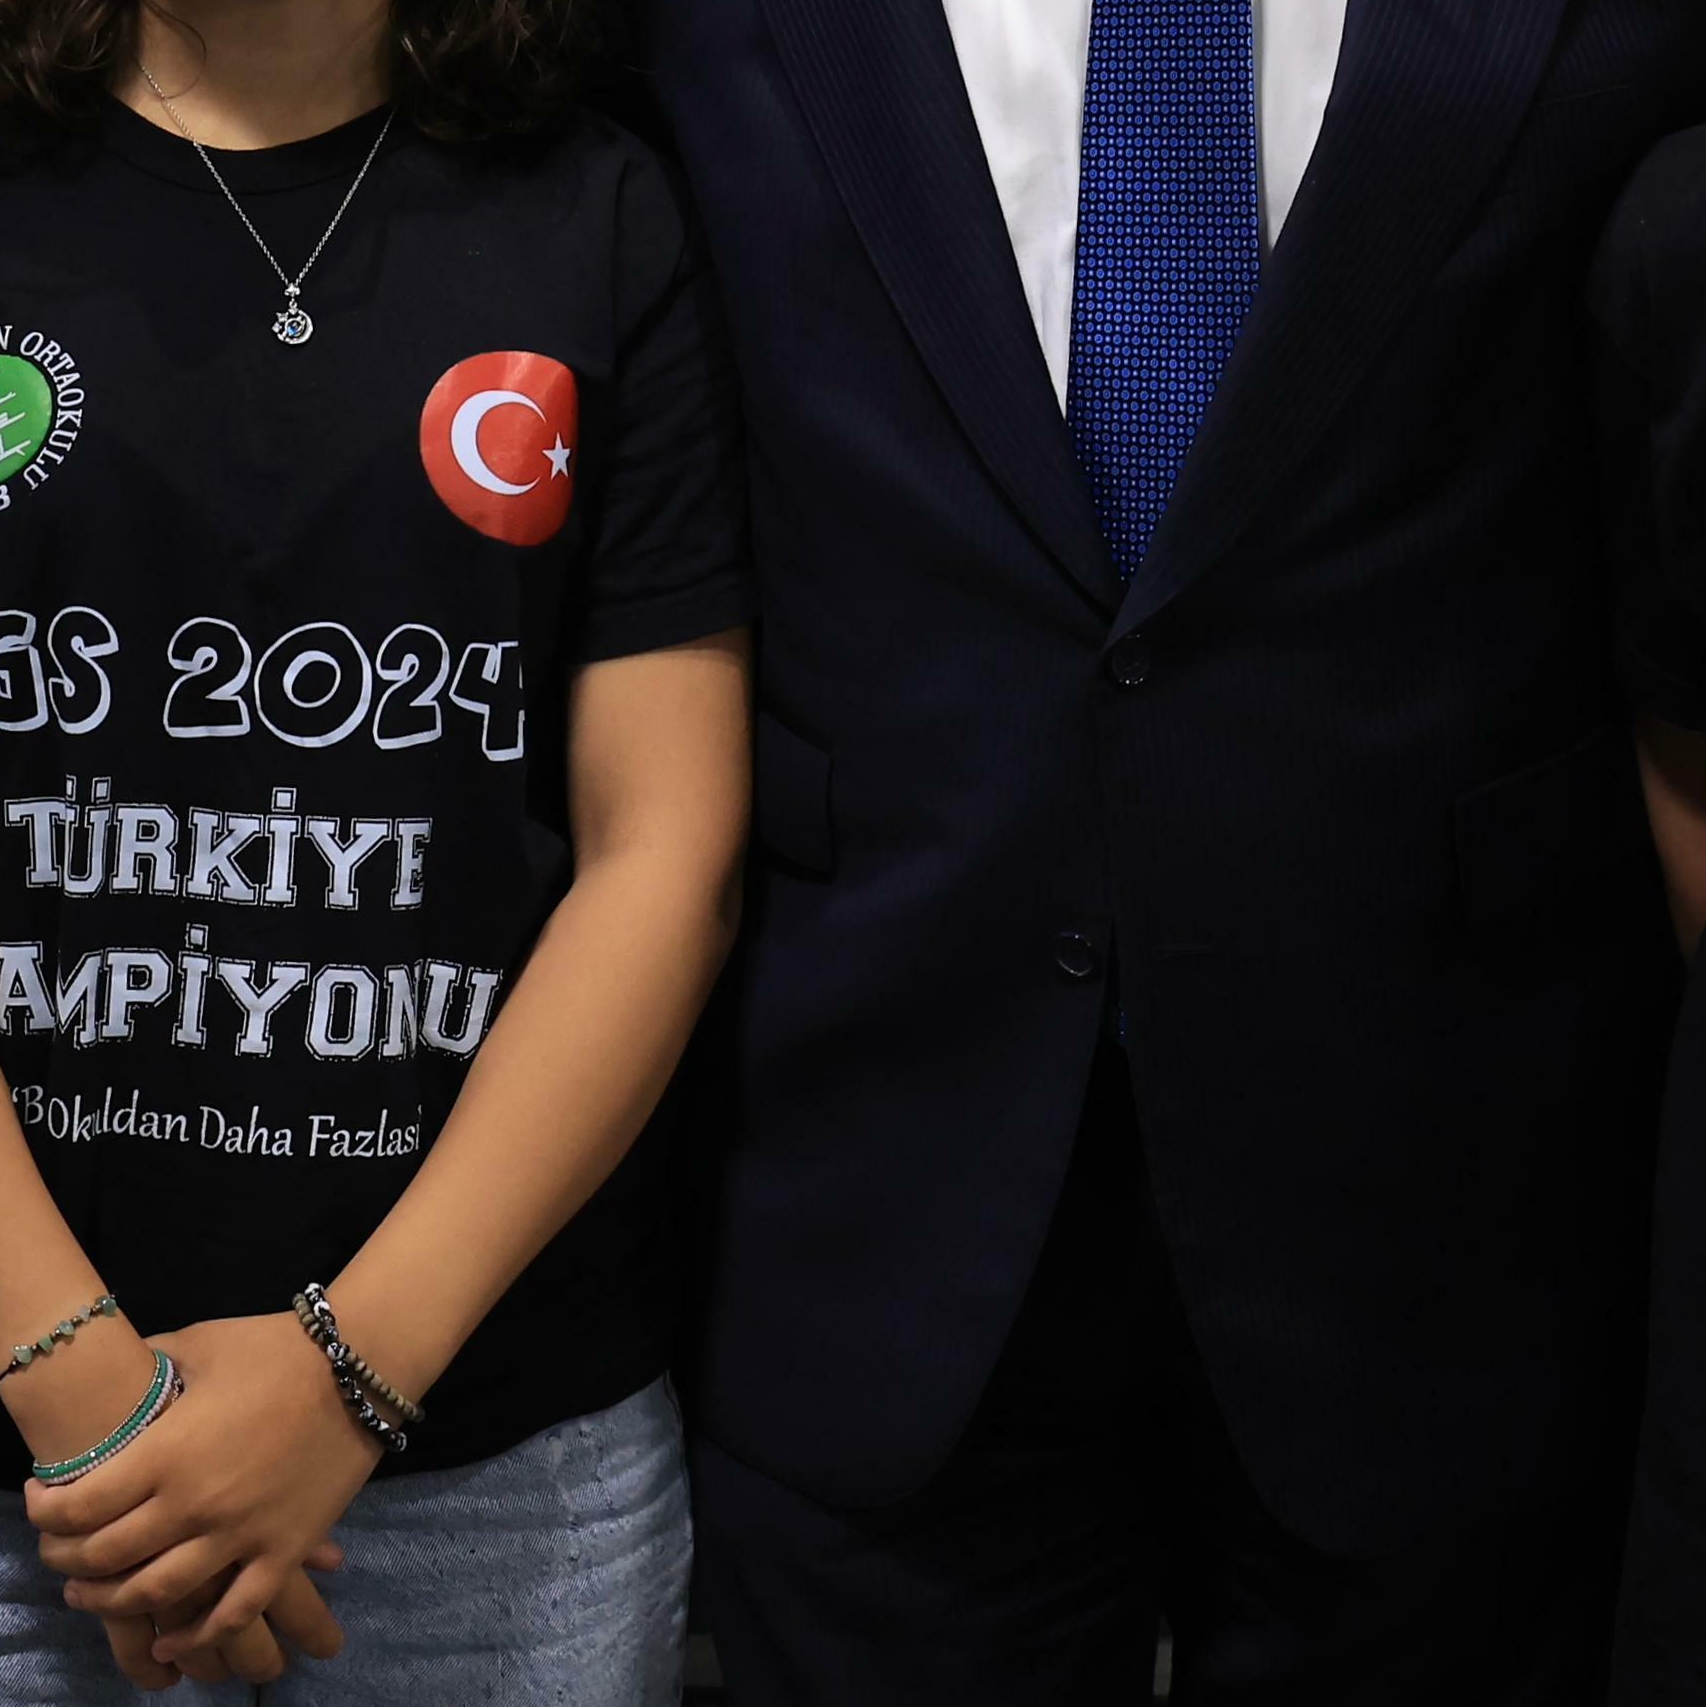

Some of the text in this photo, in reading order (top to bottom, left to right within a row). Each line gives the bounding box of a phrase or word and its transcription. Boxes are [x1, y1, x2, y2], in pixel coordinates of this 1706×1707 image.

[20, 331, 85, 490] ORTAOKULU
[163, 617, 525, 761] 2024
[4, 775, 432, 910] TÜRKİYE
[200, 1106, 293, 1156] Daha
